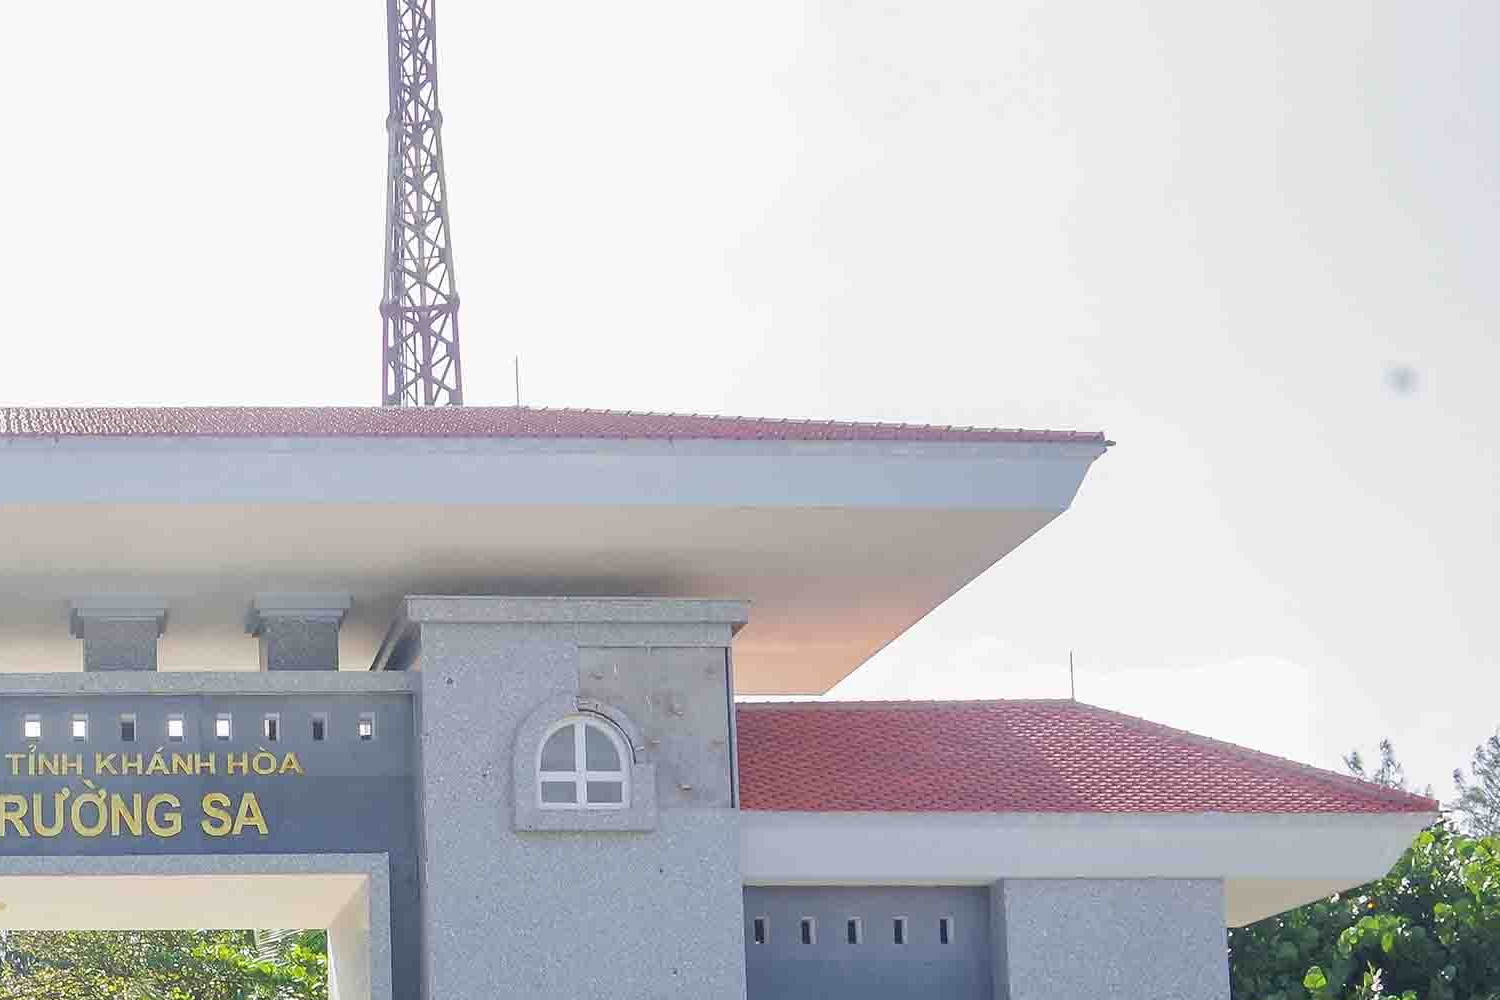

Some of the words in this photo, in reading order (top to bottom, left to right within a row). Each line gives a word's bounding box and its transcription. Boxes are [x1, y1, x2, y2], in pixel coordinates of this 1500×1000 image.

[5, 744, 83, 776] TỈNH
[94, 746, 216, 776] KHÁNH
[228, 746, 304, 776] HÒA
[201, 792, 269, 838] SA
